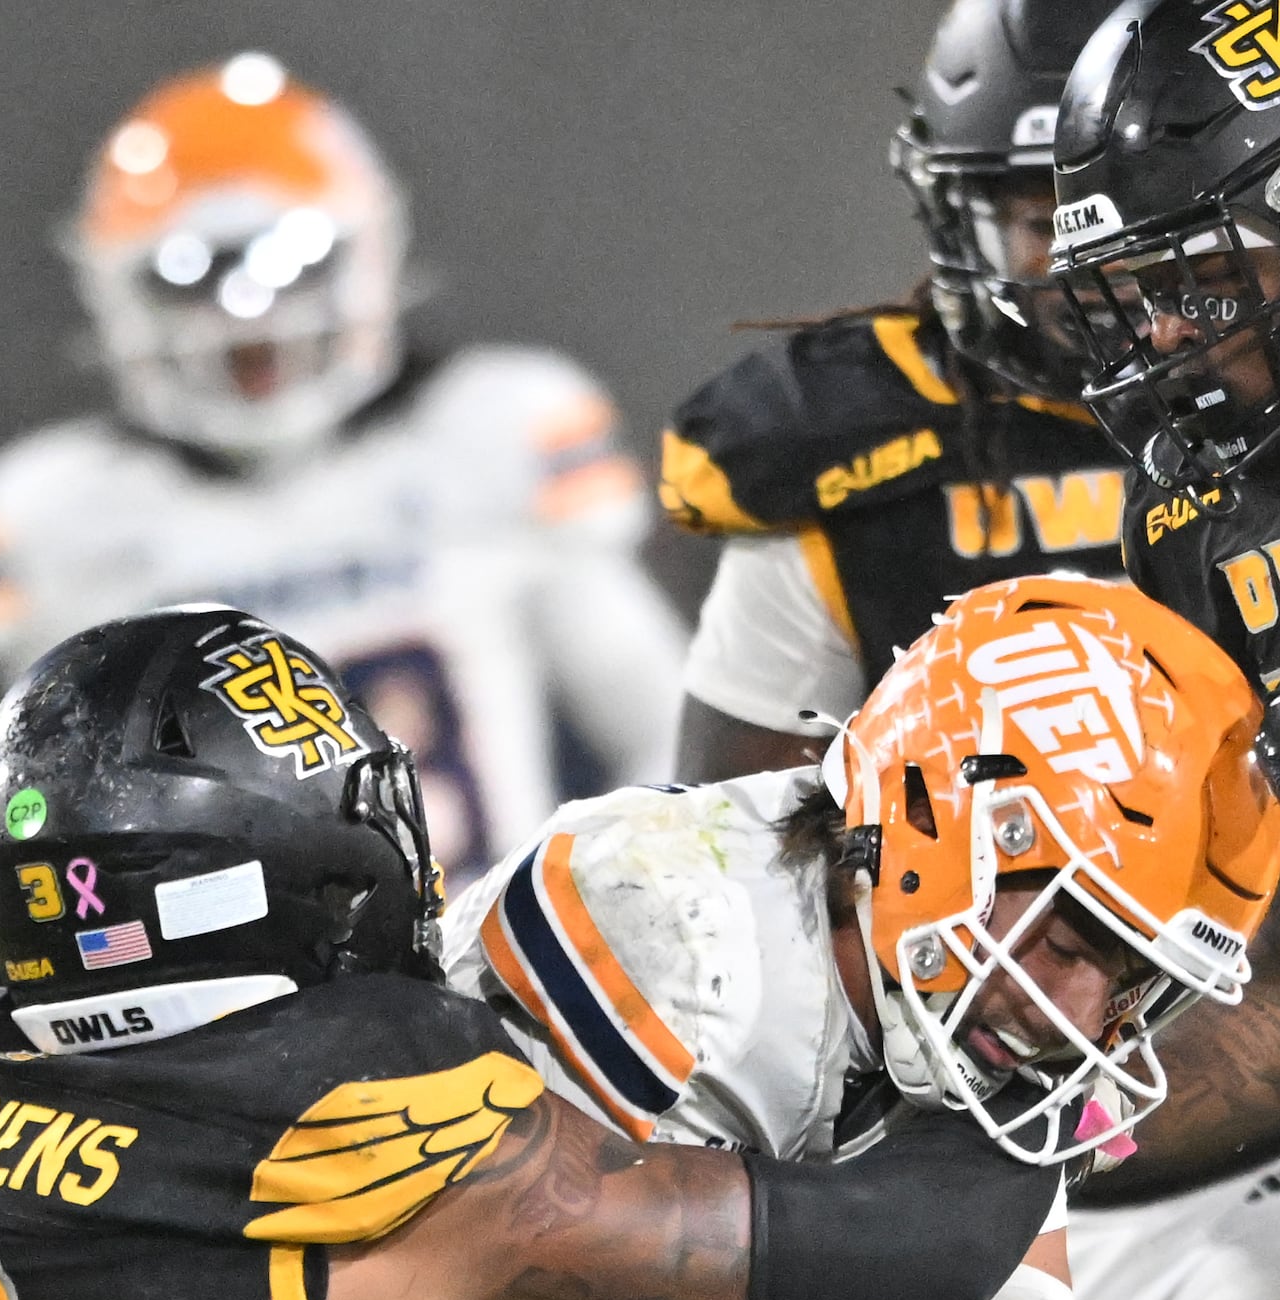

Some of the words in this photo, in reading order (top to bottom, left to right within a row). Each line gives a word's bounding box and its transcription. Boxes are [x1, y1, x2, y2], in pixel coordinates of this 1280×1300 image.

[944, 468, 1128, 559] OW
[967, 621, 1144, 784] UTEP
[15, 862, 67, 923] 3
[1192, 921, 1243, 957] UNITY
[51, 1006, 154, 1045] OWLS
